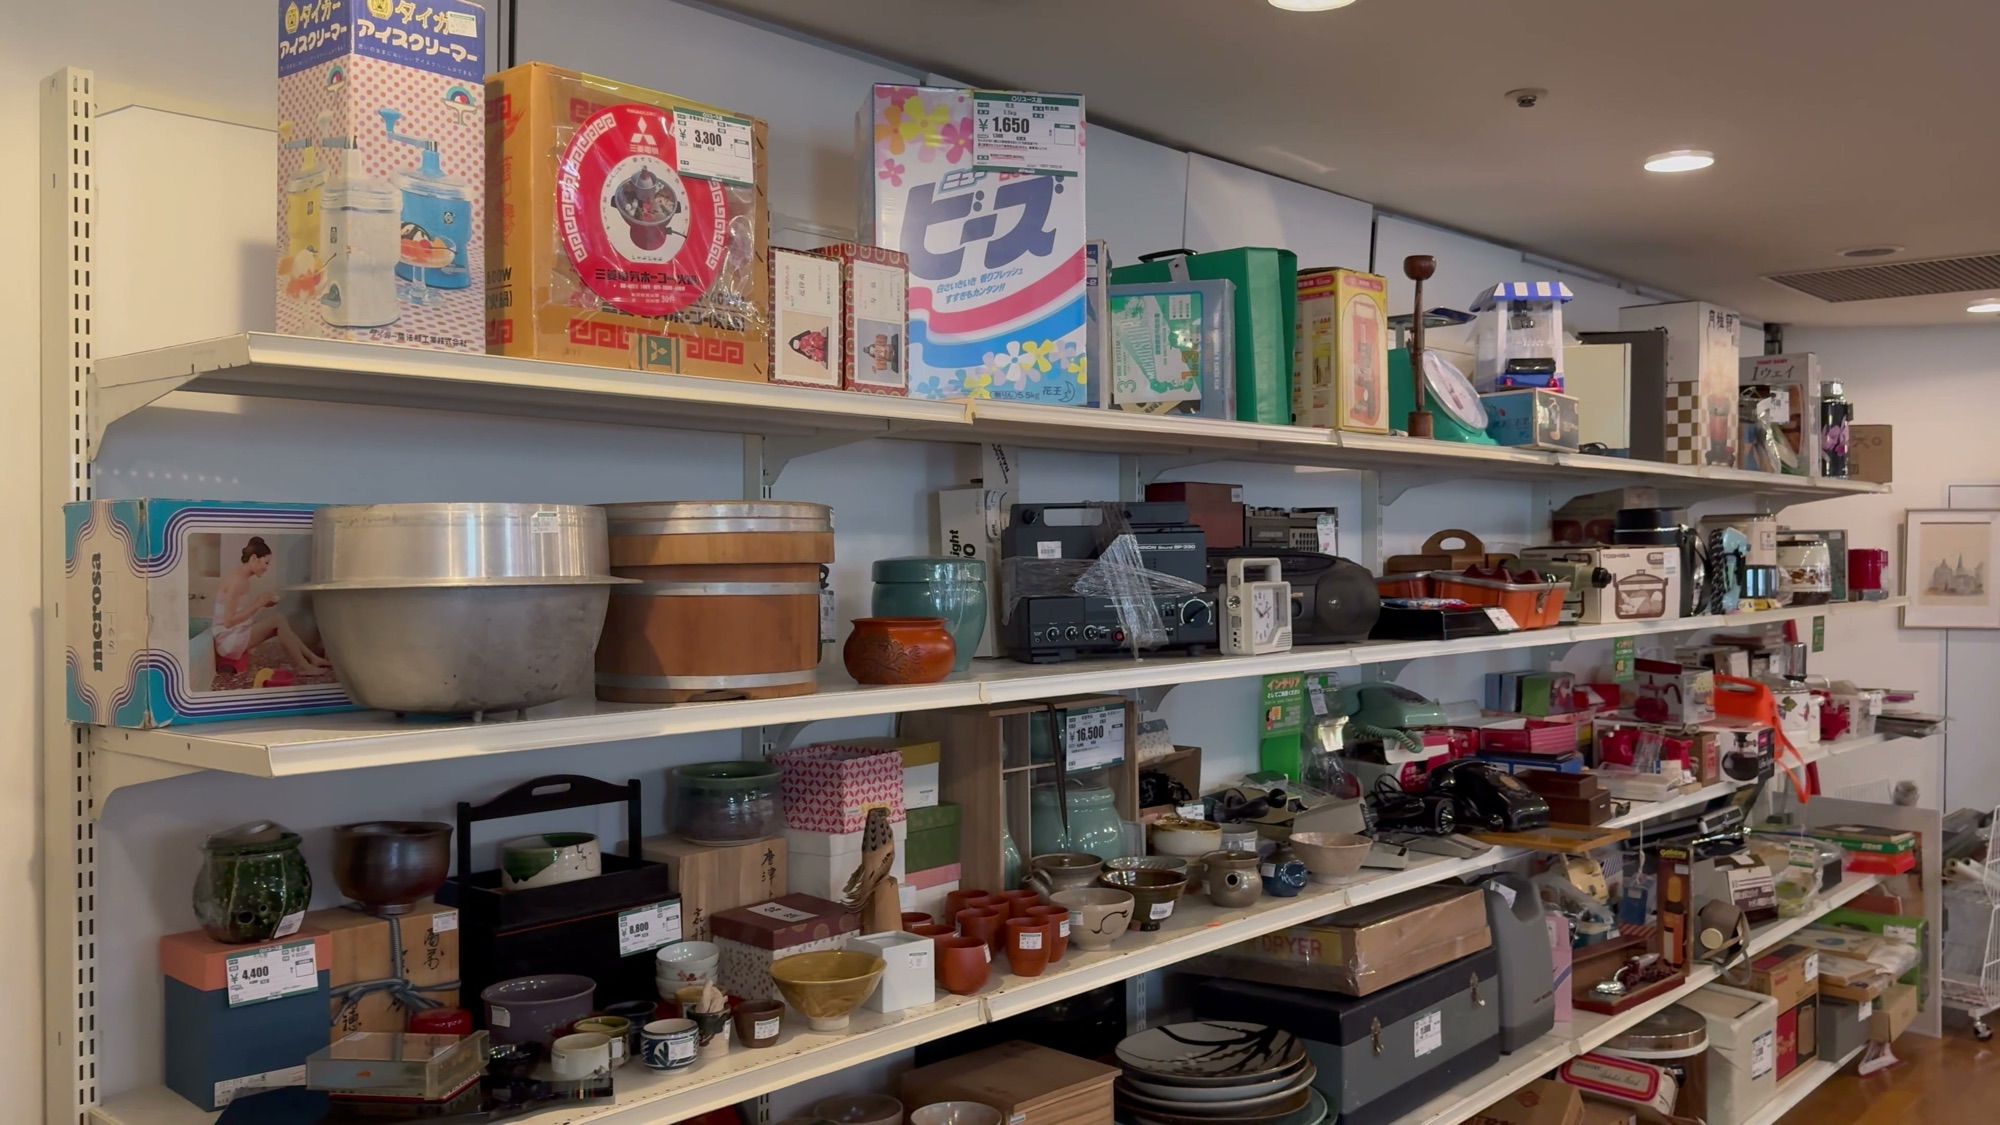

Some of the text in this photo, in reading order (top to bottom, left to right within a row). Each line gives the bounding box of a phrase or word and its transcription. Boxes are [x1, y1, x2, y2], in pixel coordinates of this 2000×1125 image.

[394, 0, 449, 35] タイガ
[280, 23, 348, 60] アイスクリーマー
[357, 19, 478, 62] アイスクリーマー
[694, 129, 723, 147] 3,300
[993, 116, 1030, 134] 1,650
[900, 175, 1065, 281] ビーズ
[936, 267, 1024, 295] 白さいきいき 香りフレッシュ
[1042, 385, 1062, 396] 花王
[949, 529, 962, 557] ight
[1076, 725, 1104, 742] 16,500
[761, 847, 777, 899] 唐津
[1262, 935, 1323, 958] DRYER
[242, 965, 270, 980] 4,400
